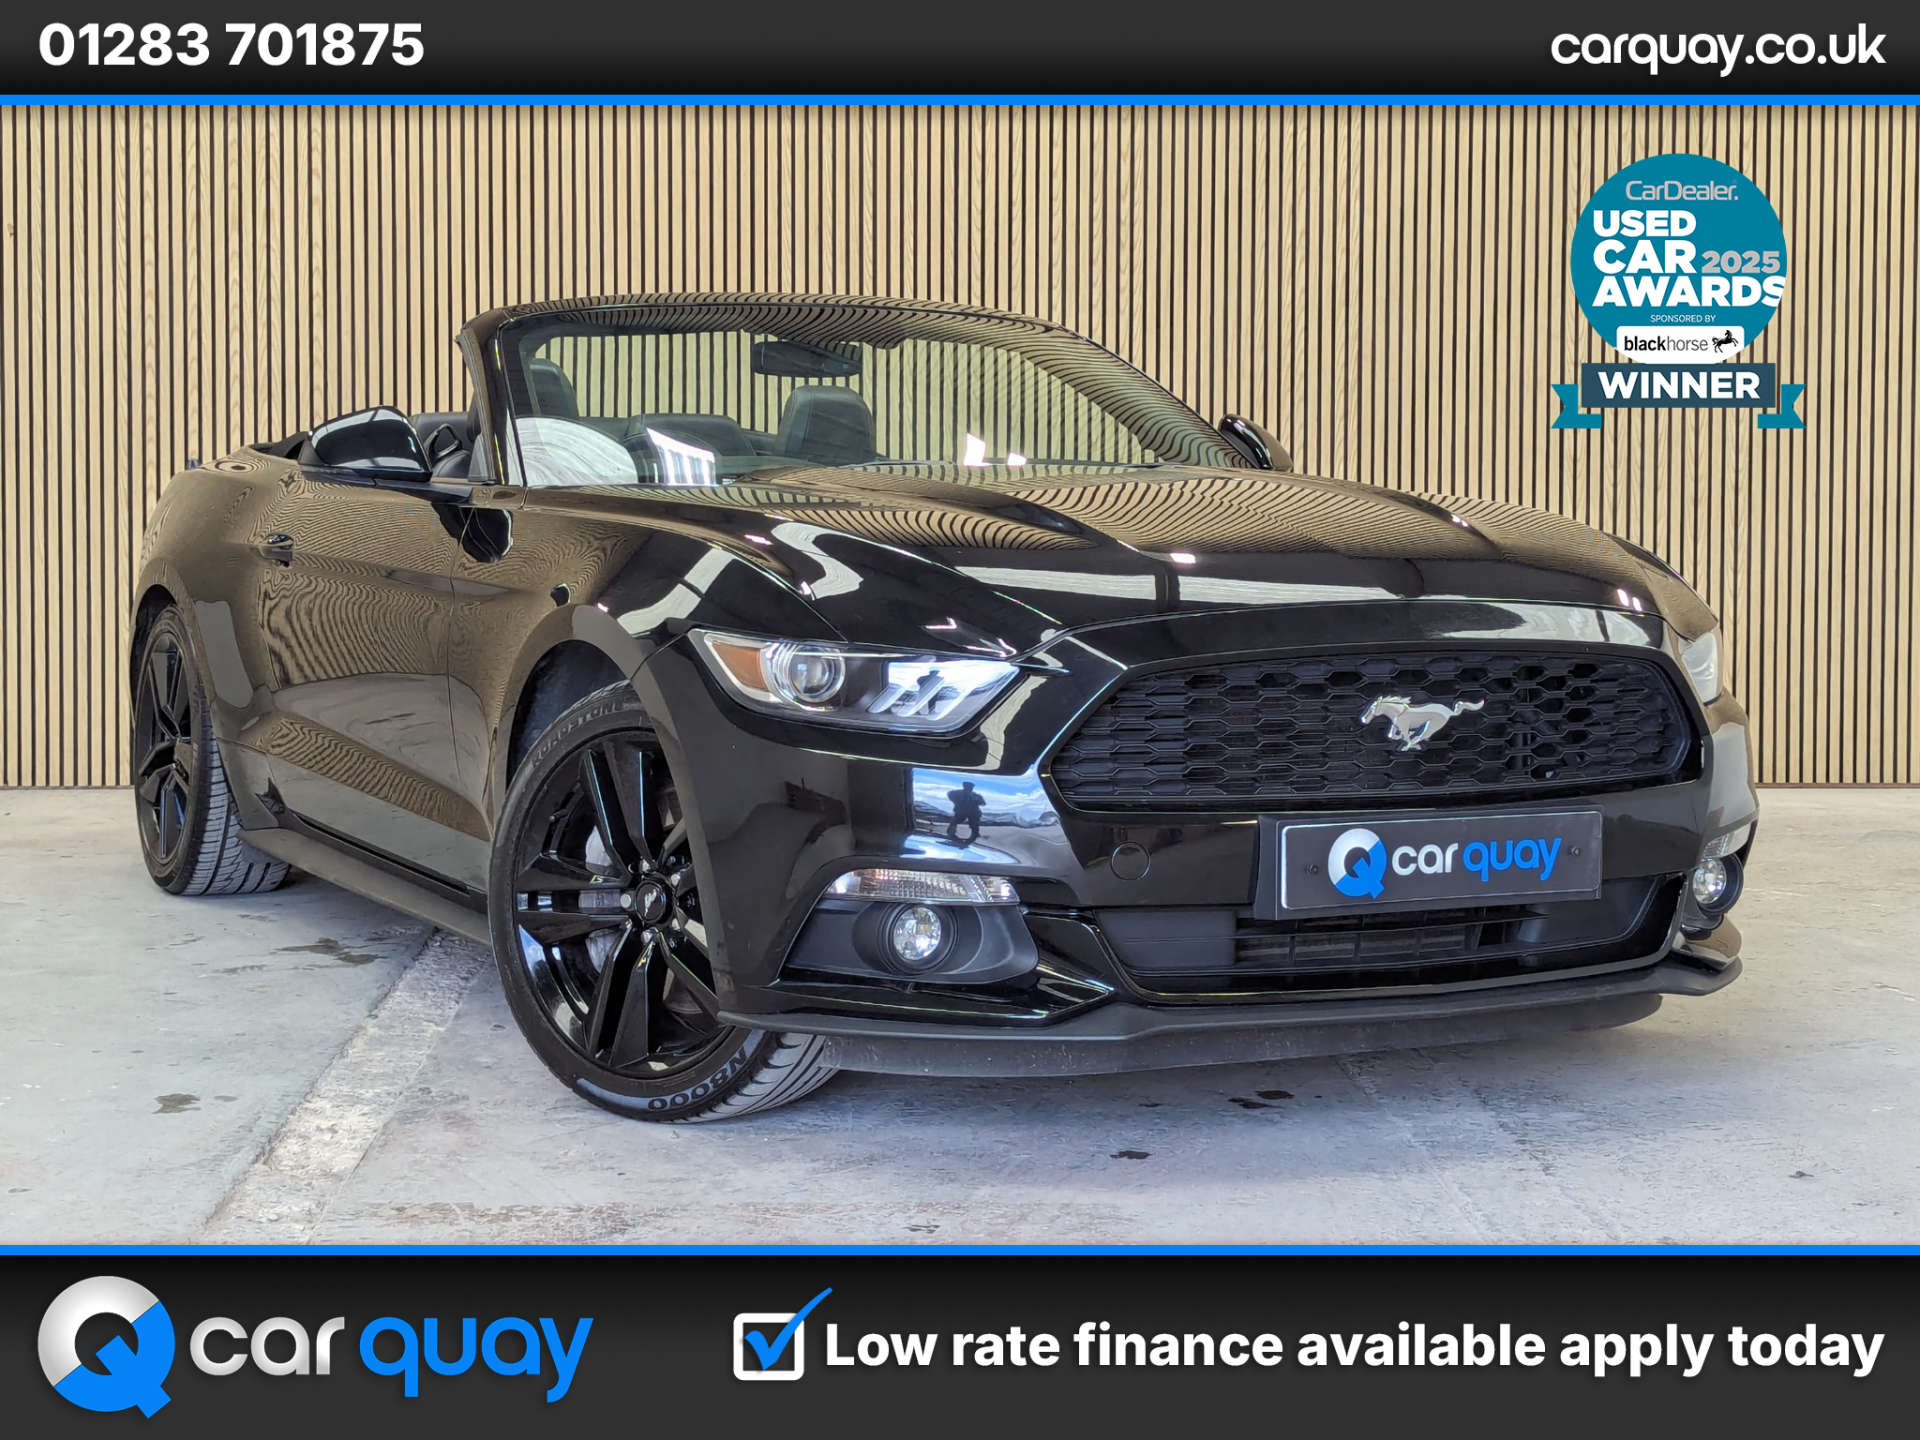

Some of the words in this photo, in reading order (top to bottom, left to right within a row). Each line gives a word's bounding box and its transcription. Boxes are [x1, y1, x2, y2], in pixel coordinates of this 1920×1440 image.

[1391, 842, 1458, 876] car
[1462, 837, 1562, 883] quay
[648, 1046, 747, 1111] N8000
